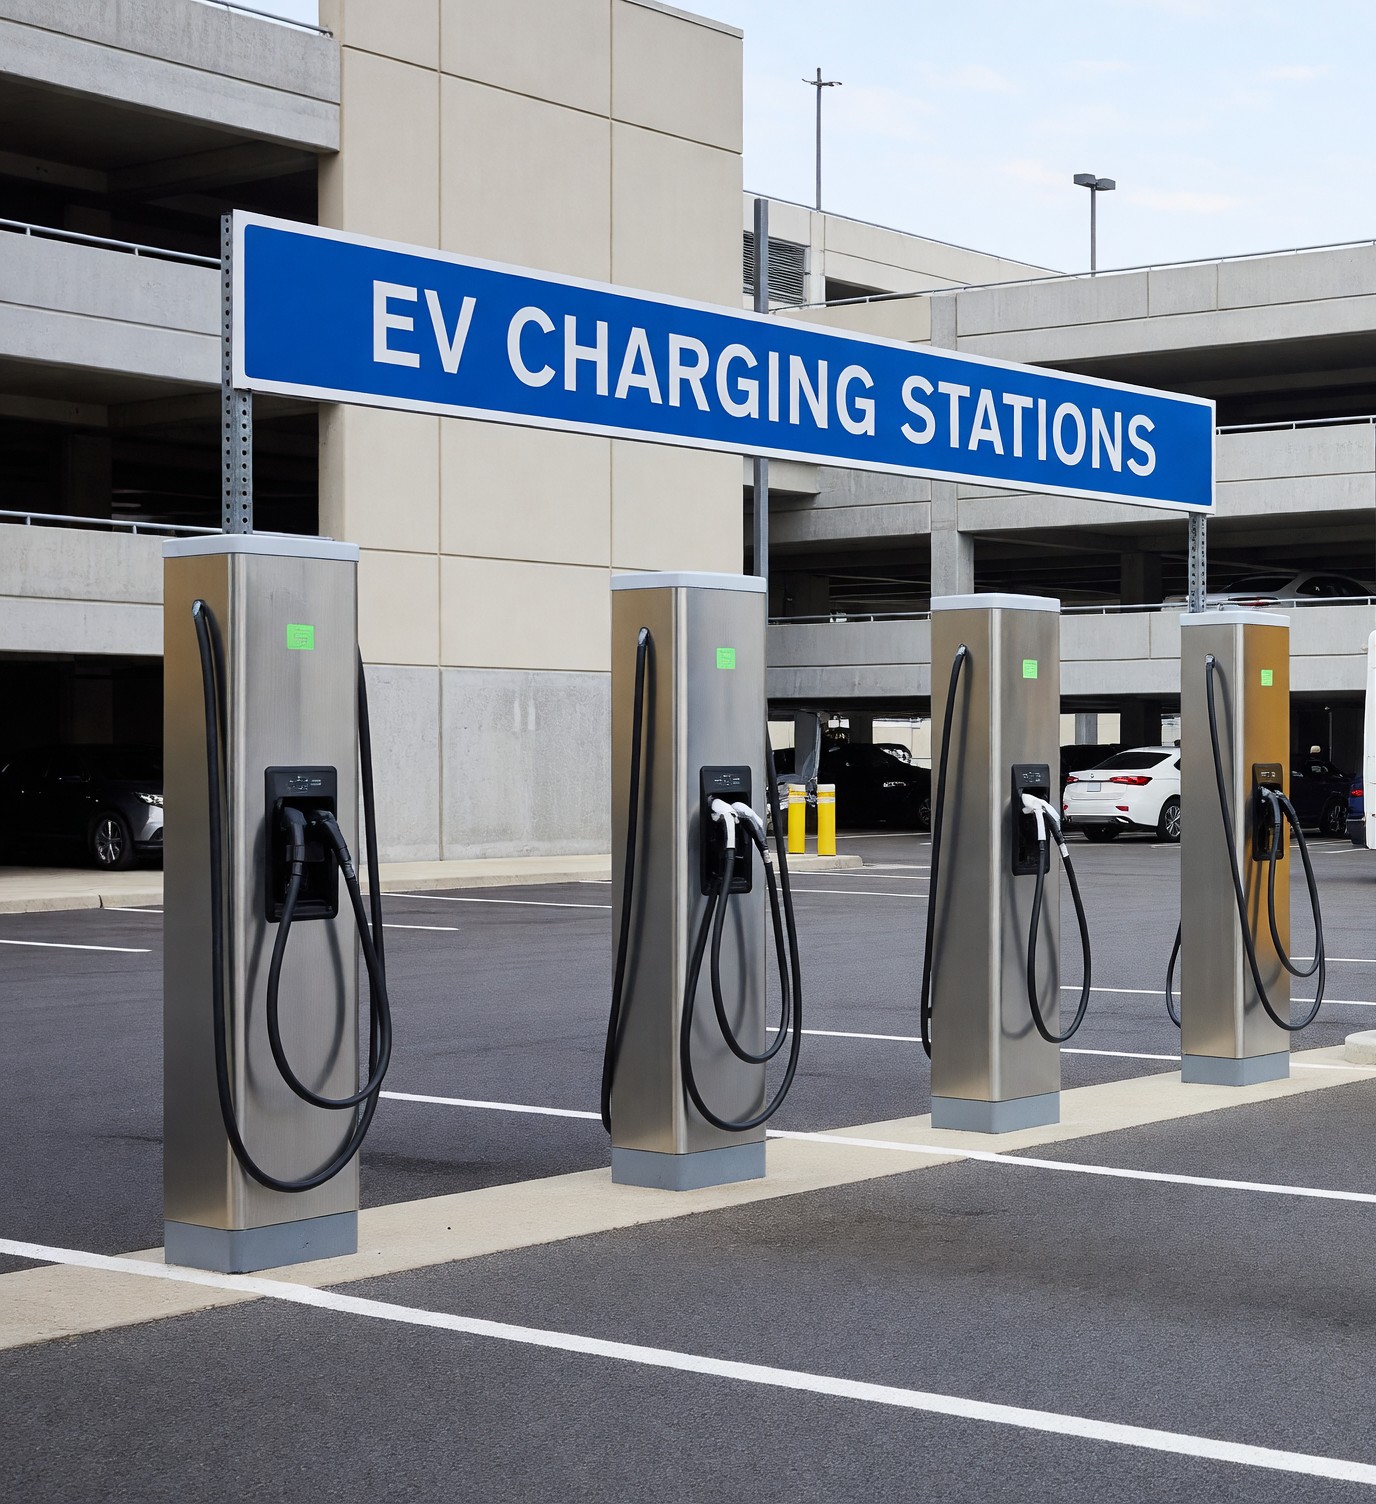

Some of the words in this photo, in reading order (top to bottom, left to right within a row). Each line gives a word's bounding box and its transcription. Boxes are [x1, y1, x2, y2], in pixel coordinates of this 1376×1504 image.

[373, 279, 477, 374] EV
[507, 306, 875, 437] CHARGING
[900, 375, 1156, 477] STATIONS
